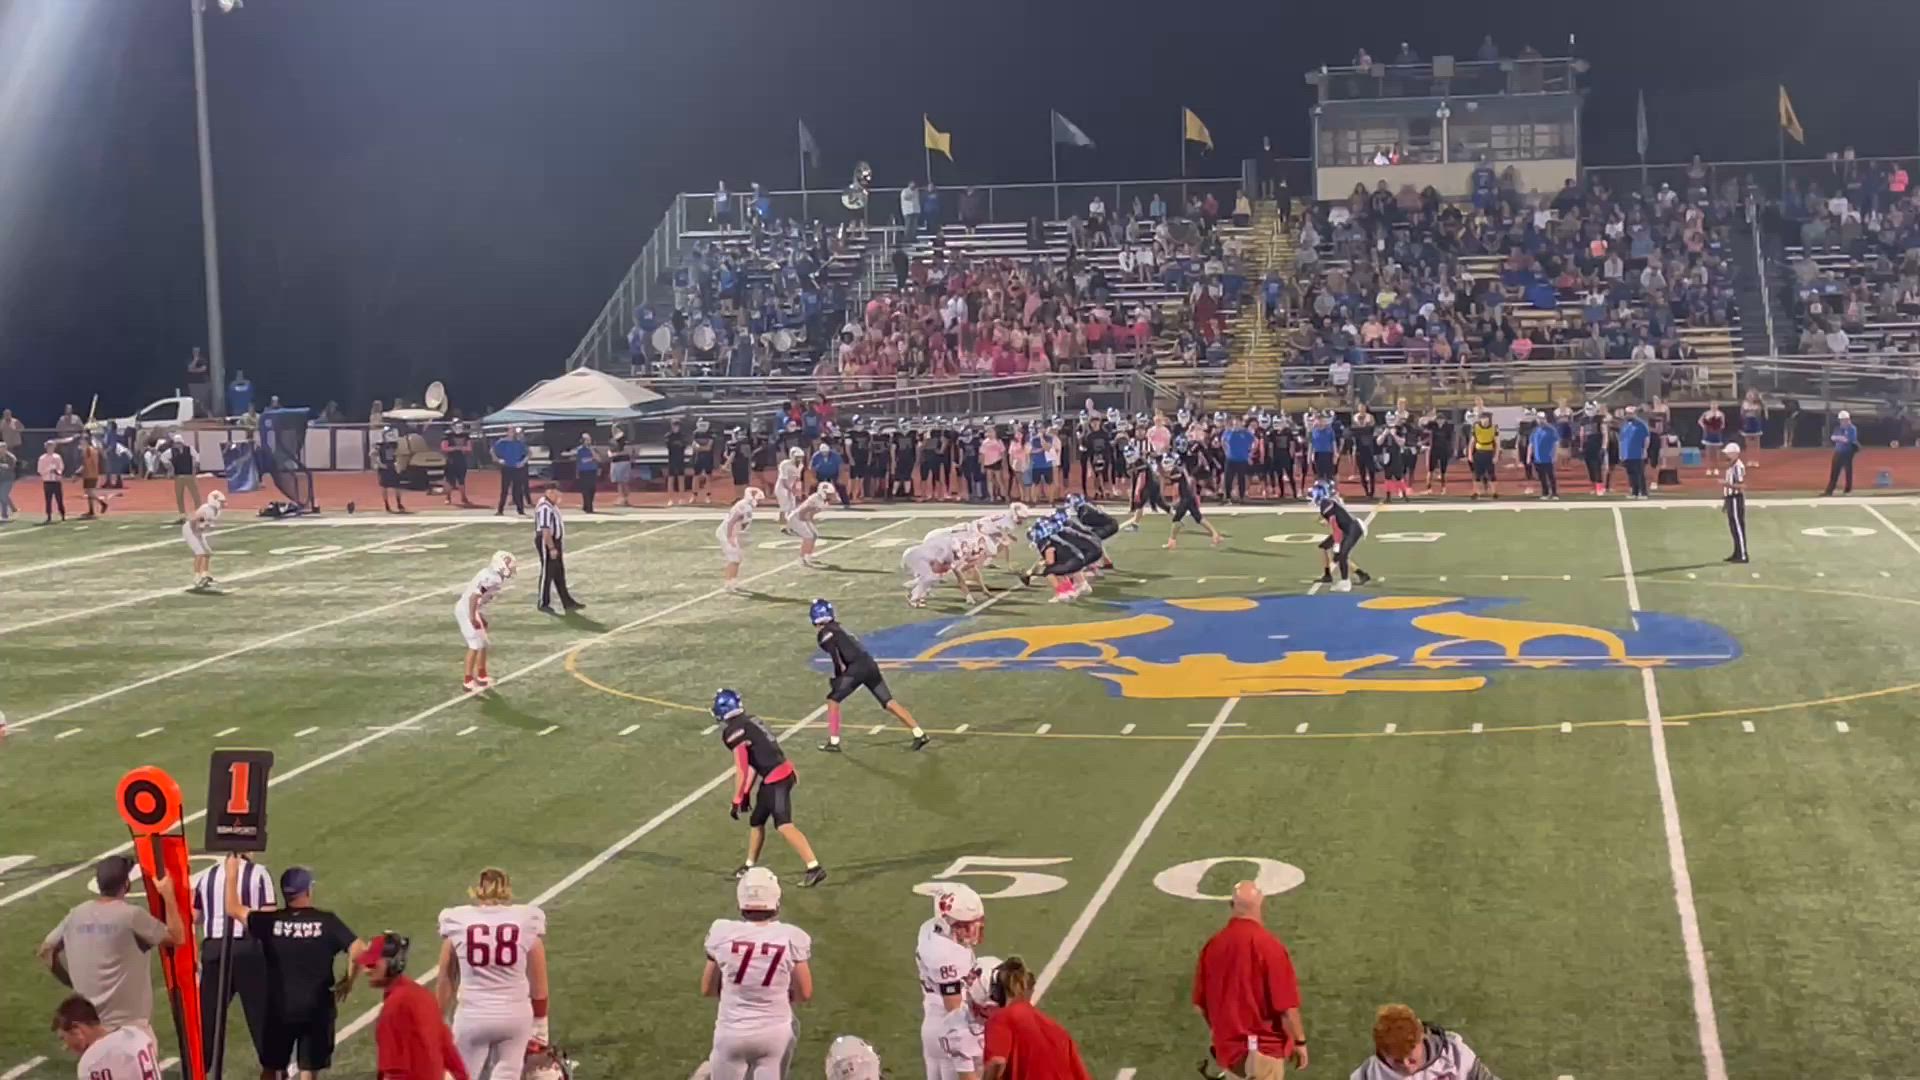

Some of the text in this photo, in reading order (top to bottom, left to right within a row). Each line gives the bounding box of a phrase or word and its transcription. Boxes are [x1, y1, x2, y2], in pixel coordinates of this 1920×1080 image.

[226, 762, 250, 814] 1
[466, 923, 519, 968] 68
[731, 940, 785, 987] 77
[940, 965, 957, 980] 85
